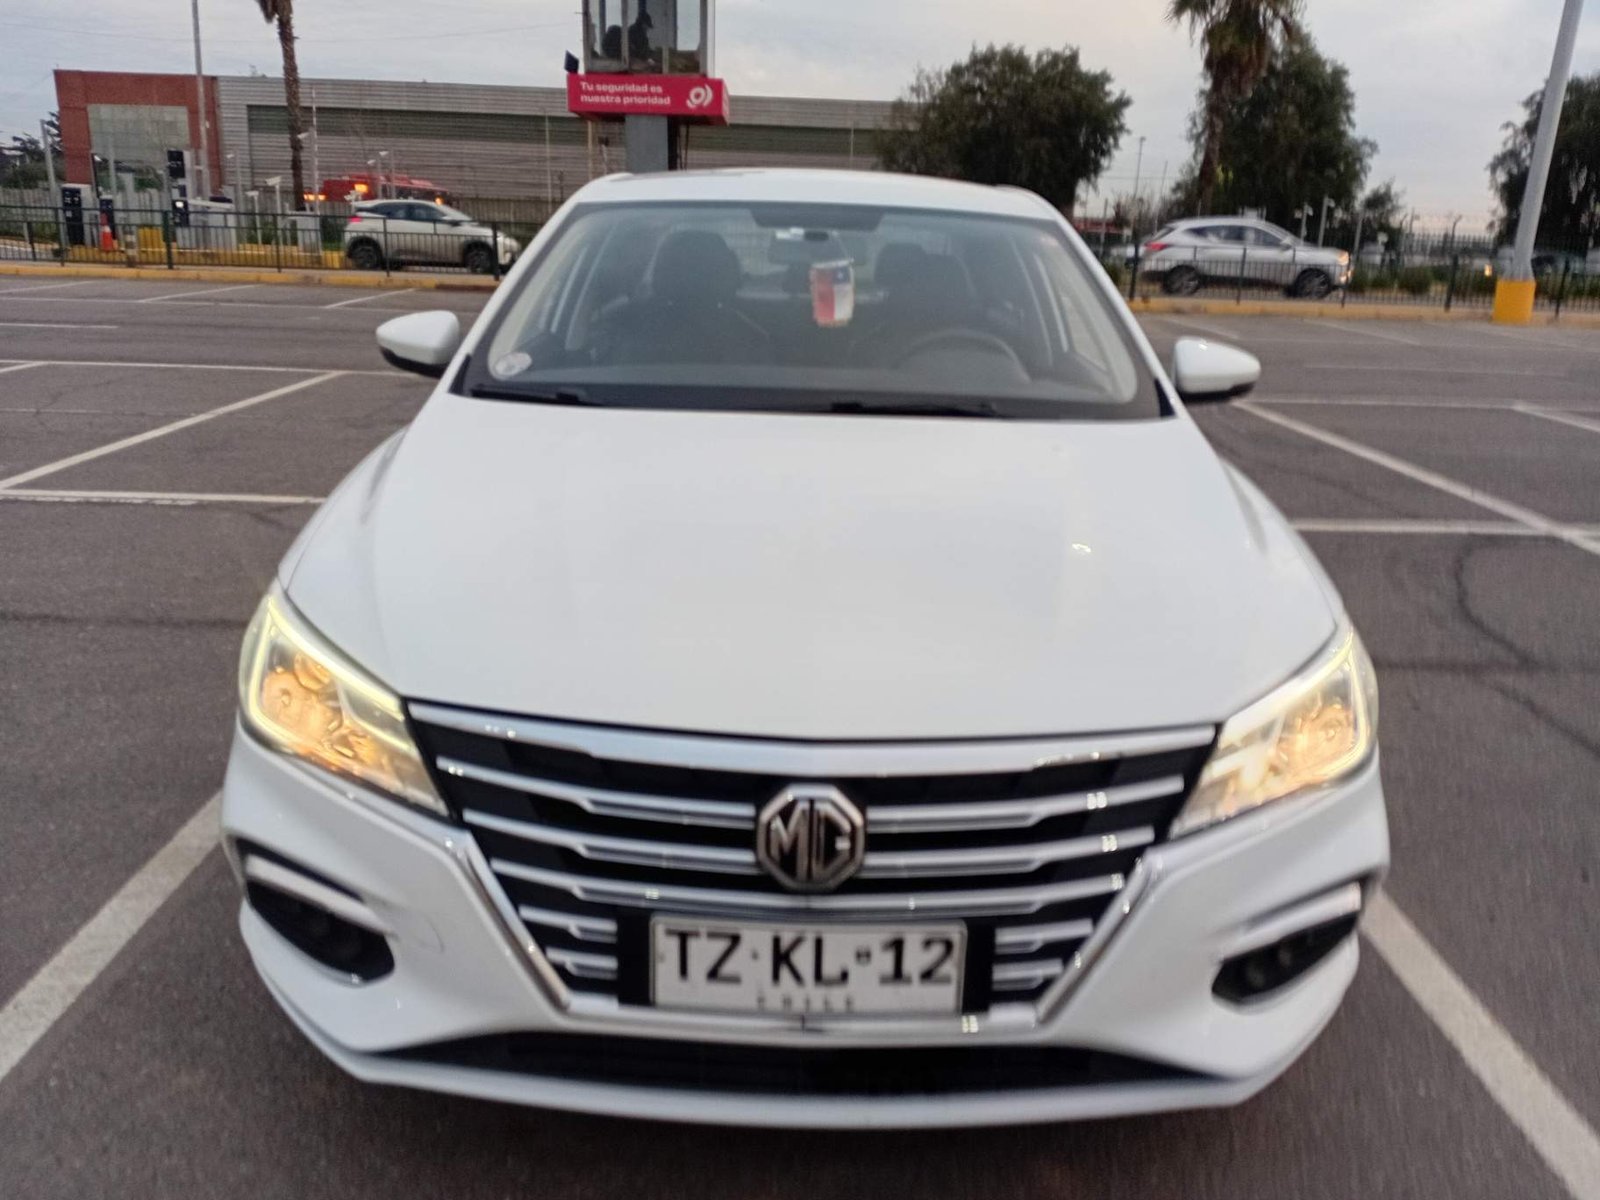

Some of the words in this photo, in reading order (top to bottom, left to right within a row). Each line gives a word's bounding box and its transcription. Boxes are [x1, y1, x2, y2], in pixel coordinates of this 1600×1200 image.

[580, 81, 594, 91] Tu
[596, 83, 648, 93] seguridad
[650, 85, 662, 93] es
[580, 94, 621, 103] nuestra
[623, 95, 670, 105] prioridad
[767, 796, 853, 883] MG
